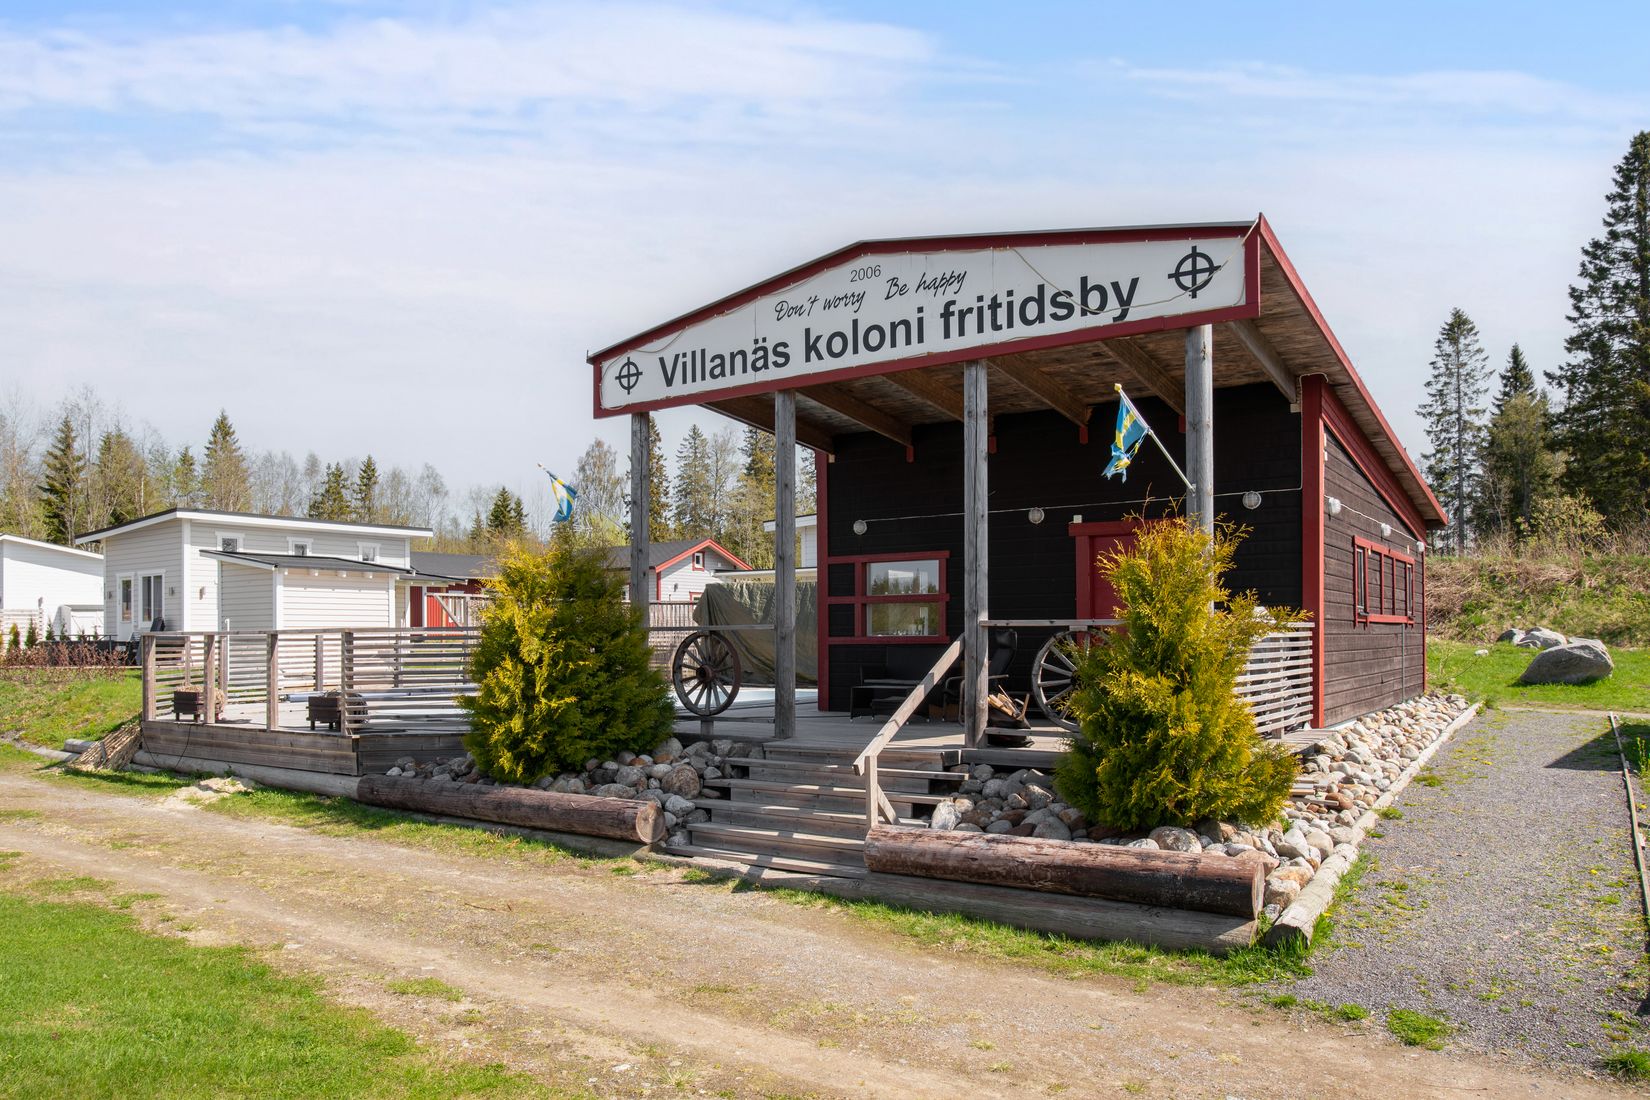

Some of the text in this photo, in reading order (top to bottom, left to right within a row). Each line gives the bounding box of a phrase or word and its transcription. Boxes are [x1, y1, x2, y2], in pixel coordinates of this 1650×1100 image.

[774, 270, 967, 321] Don't worry Be happy
[850, 264, 881, 283] 2006
[659, 275, 1140, 388] Villanäs koloni fritidsby
